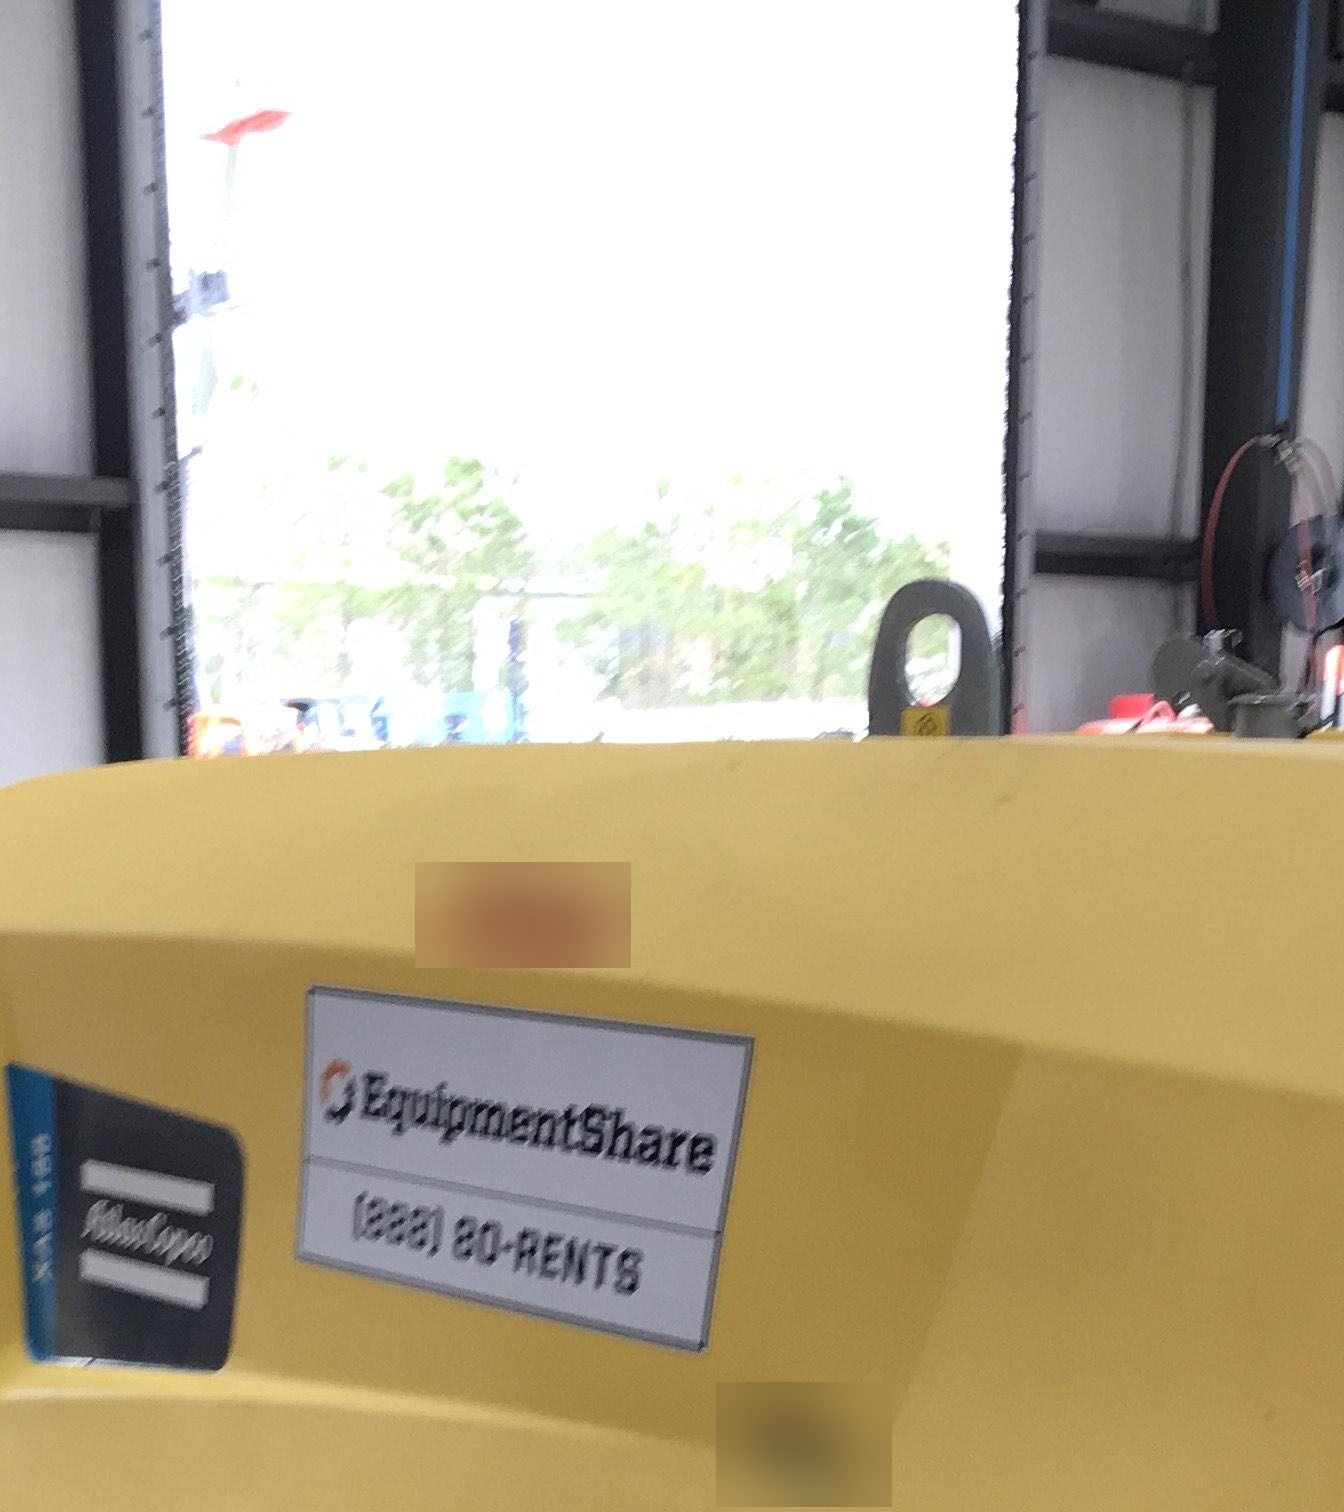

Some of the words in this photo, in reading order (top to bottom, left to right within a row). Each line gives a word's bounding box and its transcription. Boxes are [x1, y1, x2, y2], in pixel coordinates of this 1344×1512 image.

[360, 1069, 719, 1177] EquipmentShare
[353, 1190, 445, 1258] (888)
[451, 1214, 646, 1297] 80-RENTS
